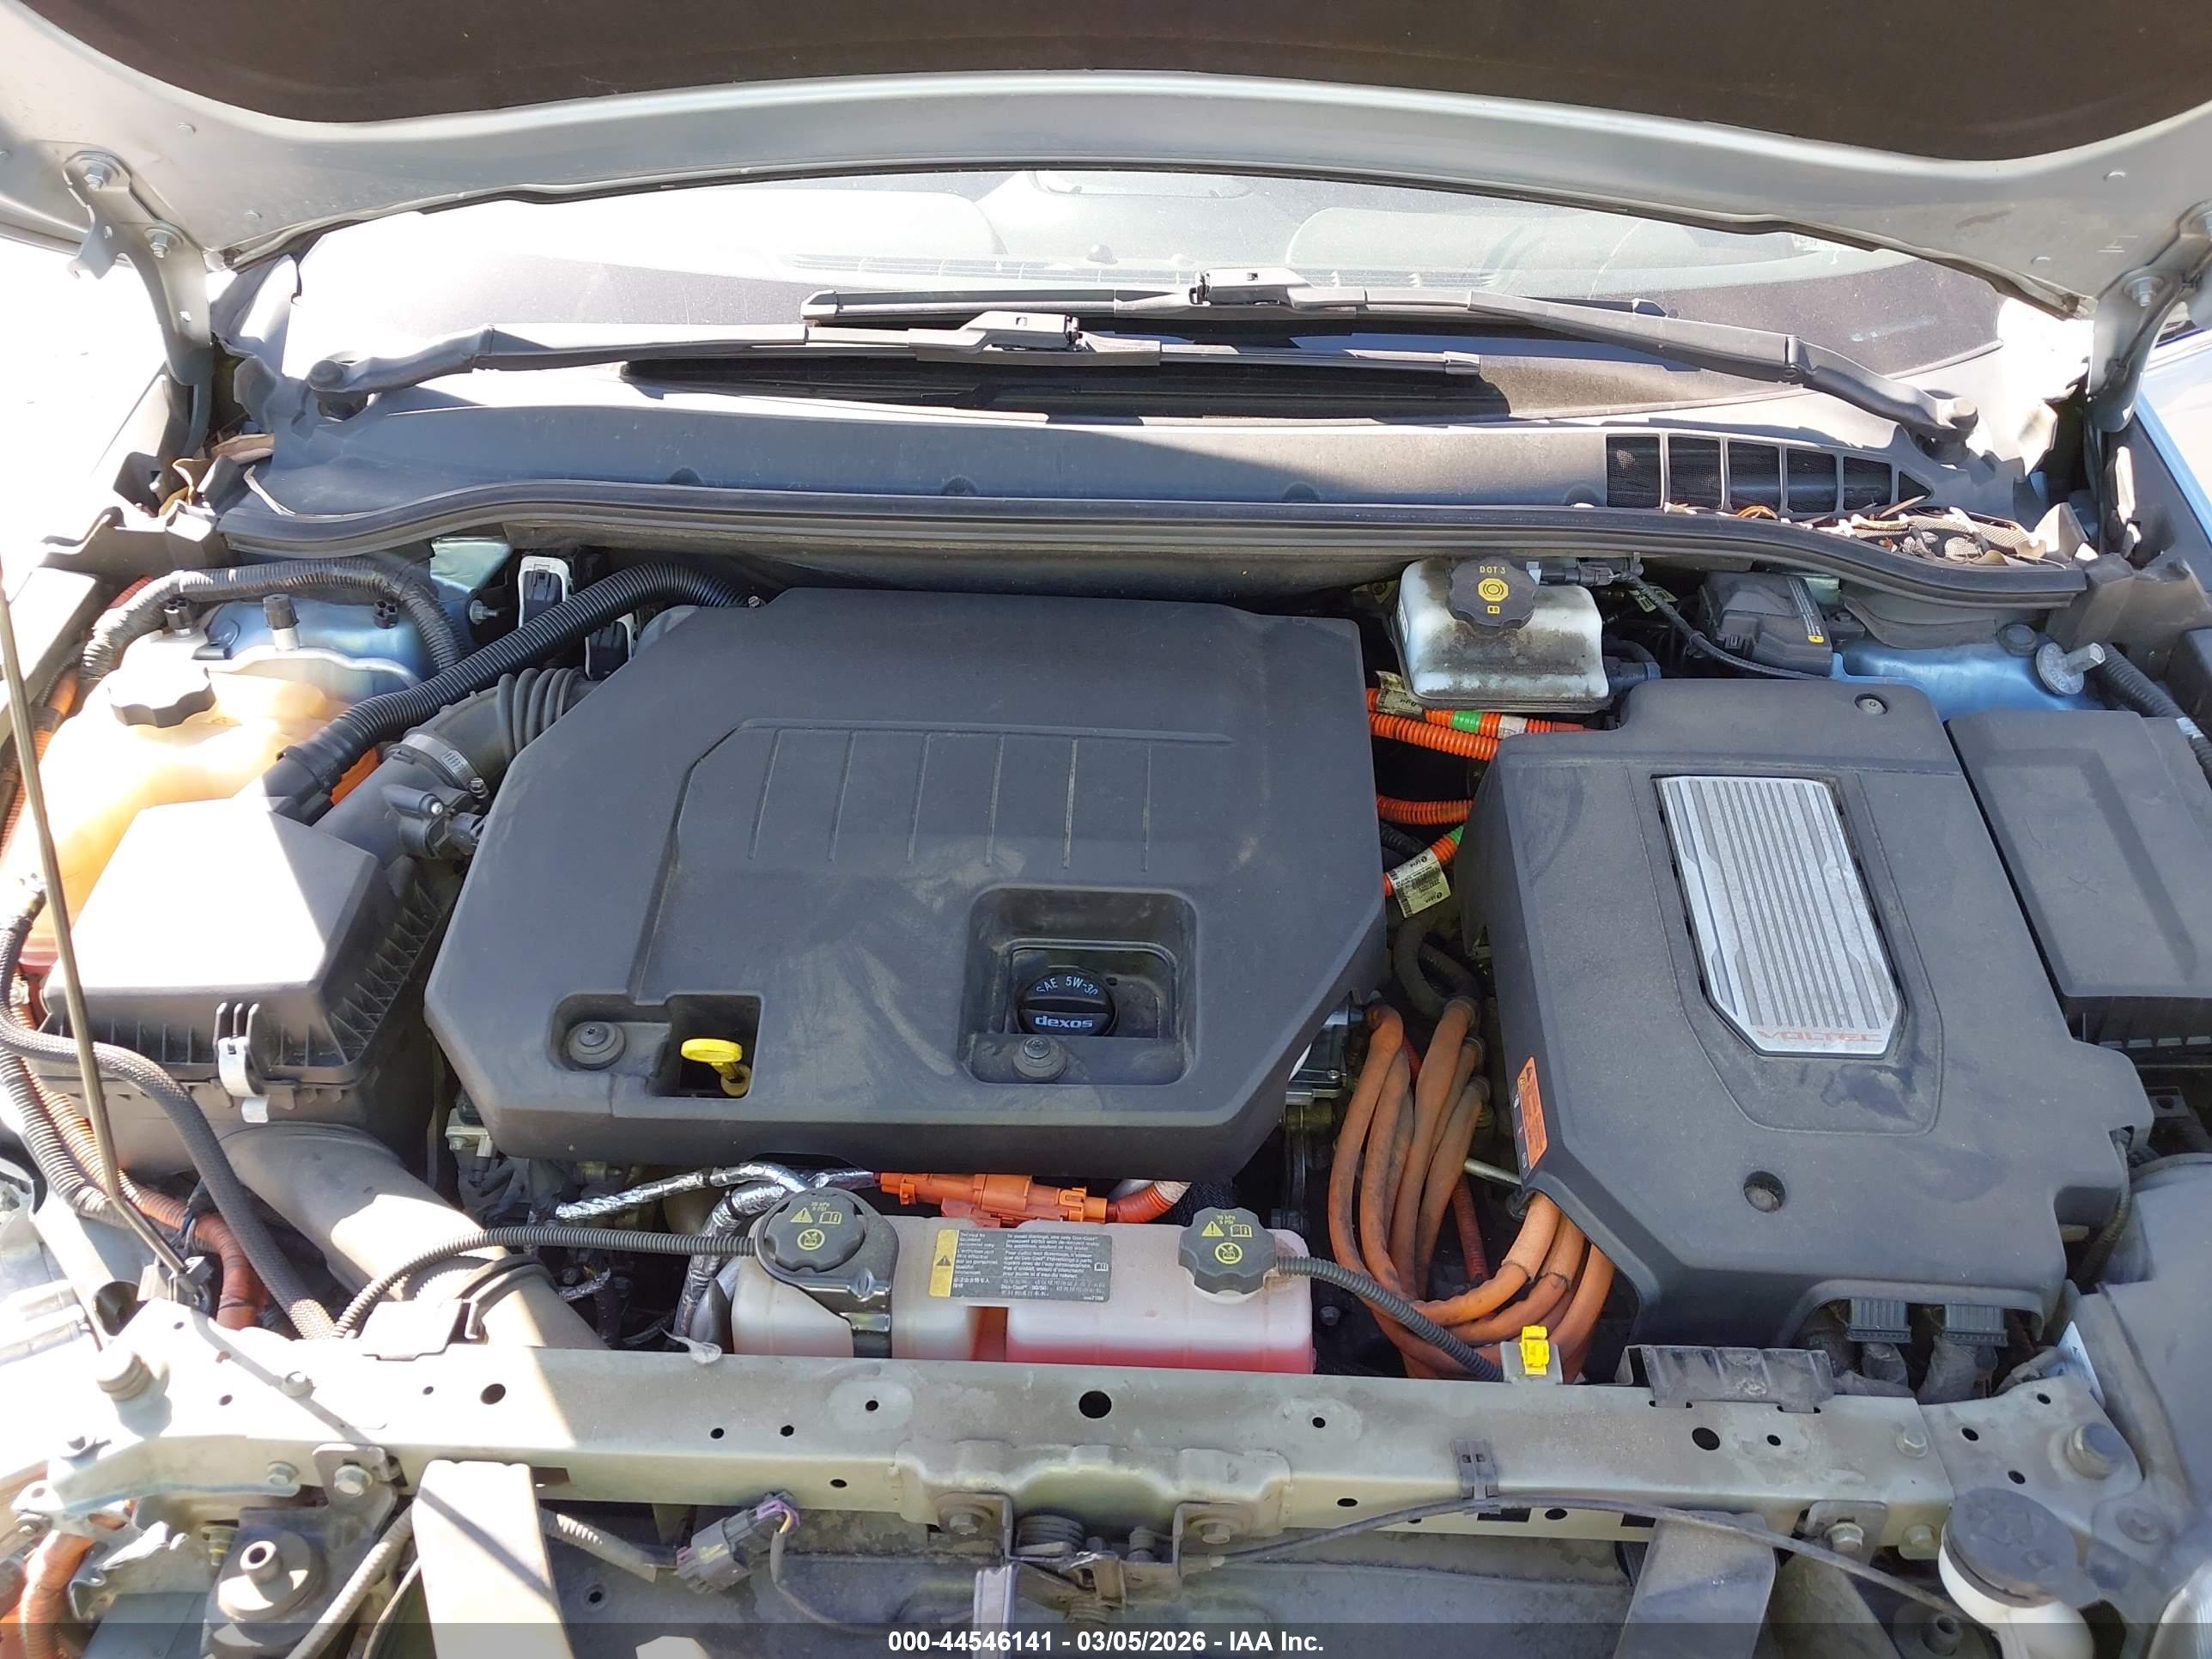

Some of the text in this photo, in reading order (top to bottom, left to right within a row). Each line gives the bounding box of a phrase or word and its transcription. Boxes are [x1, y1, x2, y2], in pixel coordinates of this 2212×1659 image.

[1480, 565, 1506, 574] DOT 3
[1036, 977, 1059, 995] SAE
[1034, 1015, 1093, 1029] dexos
[1757, 1029, 1883, 1043] VOLTEC
